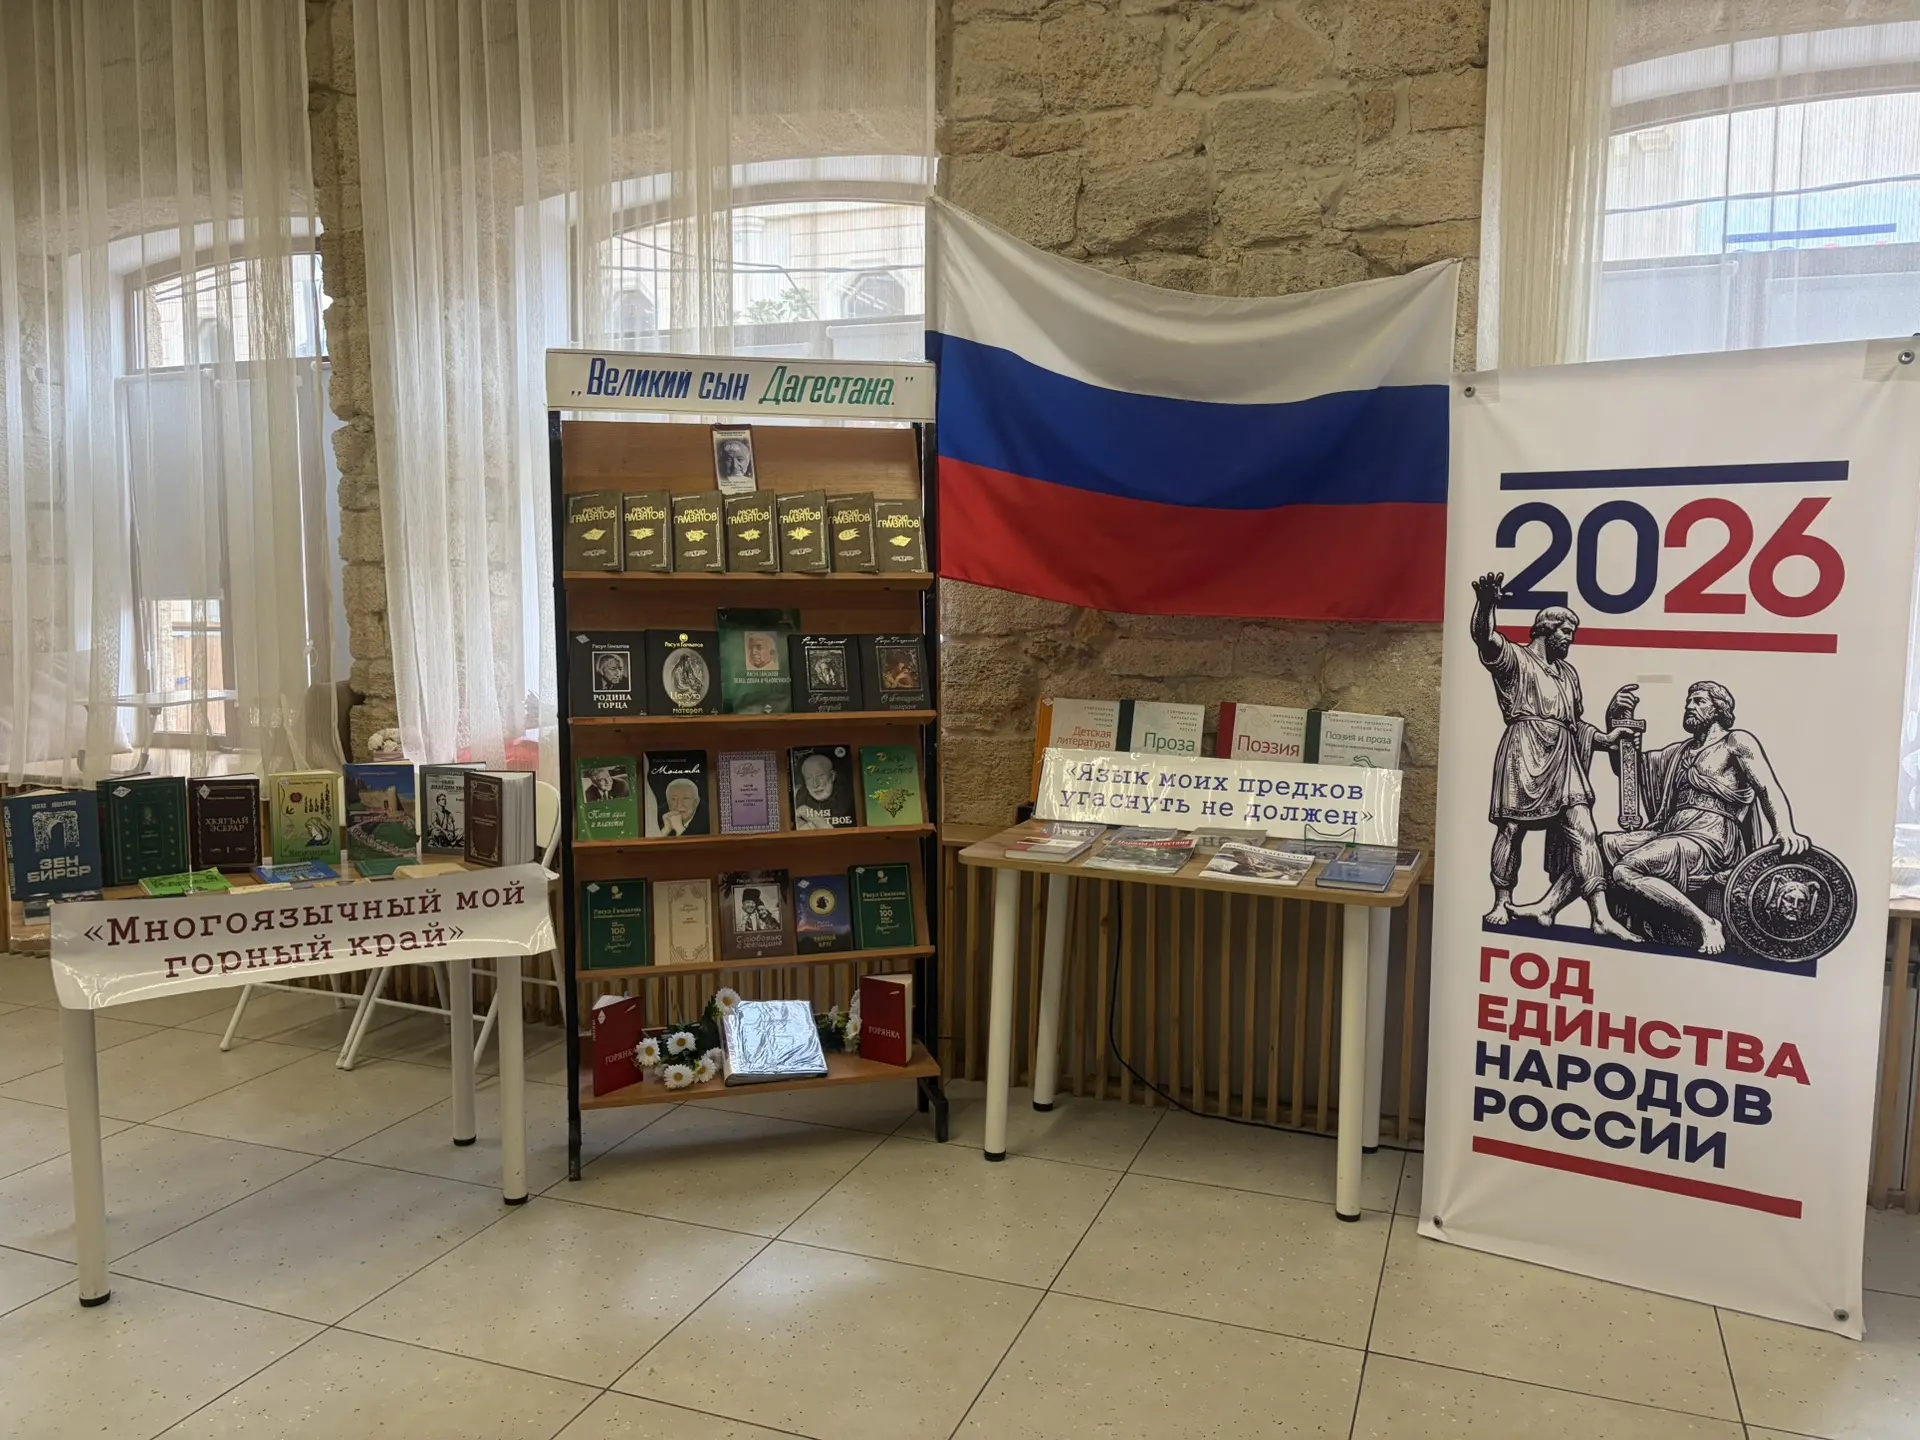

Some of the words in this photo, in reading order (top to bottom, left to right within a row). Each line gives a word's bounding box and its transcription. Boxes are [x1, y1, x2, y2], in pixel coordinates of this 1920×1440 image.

[698, 371, 749, 401] сын
[624, 510, 665, 523] АМЗАТОВ
[1495, 497, 1846, 618] 2026
[593, 693, 632, 701] РОДИНА
[597, 701, 628, 709] ГОРЦА
[670, 691, 701, 703] Целую
[1073, 726, 1112, 738] Детская
[1325, 730, 1356, 741] Поэзия
[1366, 736, 1392, 745] проза
[1056, 736, 1111, 749] литература
[1144, 732, 1195, 753] Проза
[1237, 734, 1300, 757] Поэзия
[1066, 763, 1150, 786] «Язык
[1159, 773, 1228, 791] моих
[1238, 778, 1363, 800] предков
[805, 808, 831, 818] ИМЯ
[1060, 790, 1190, 814] угаснуть
[1201, 800, 1234, 817] не
[1244, 803, 1374, 826] должен»
[210, 824, 245, 832] ЭСЕРАР
[39, 855, 79, 870] ЗЕН
[27, 865, 92, 883] БИРОР
[84, 888, 442, 947] «Многоязычный
[456, 880, 525, 910] мой
[880, 909, 893, 917] 100
[164, 933, 334, 979] горный
[348, 921, 464, 958] край»
[1480, 946, 1594, 1005] ГОД
[868, 1026, 901, 1039] ГОРЯНКА
[1477, 993, 1811, 1086] ЕДИНСТВА
[1475, 1040, 1773, 1126] НАРОДОВ
[1473, 1087, 1727, 1170] РОССИИ
